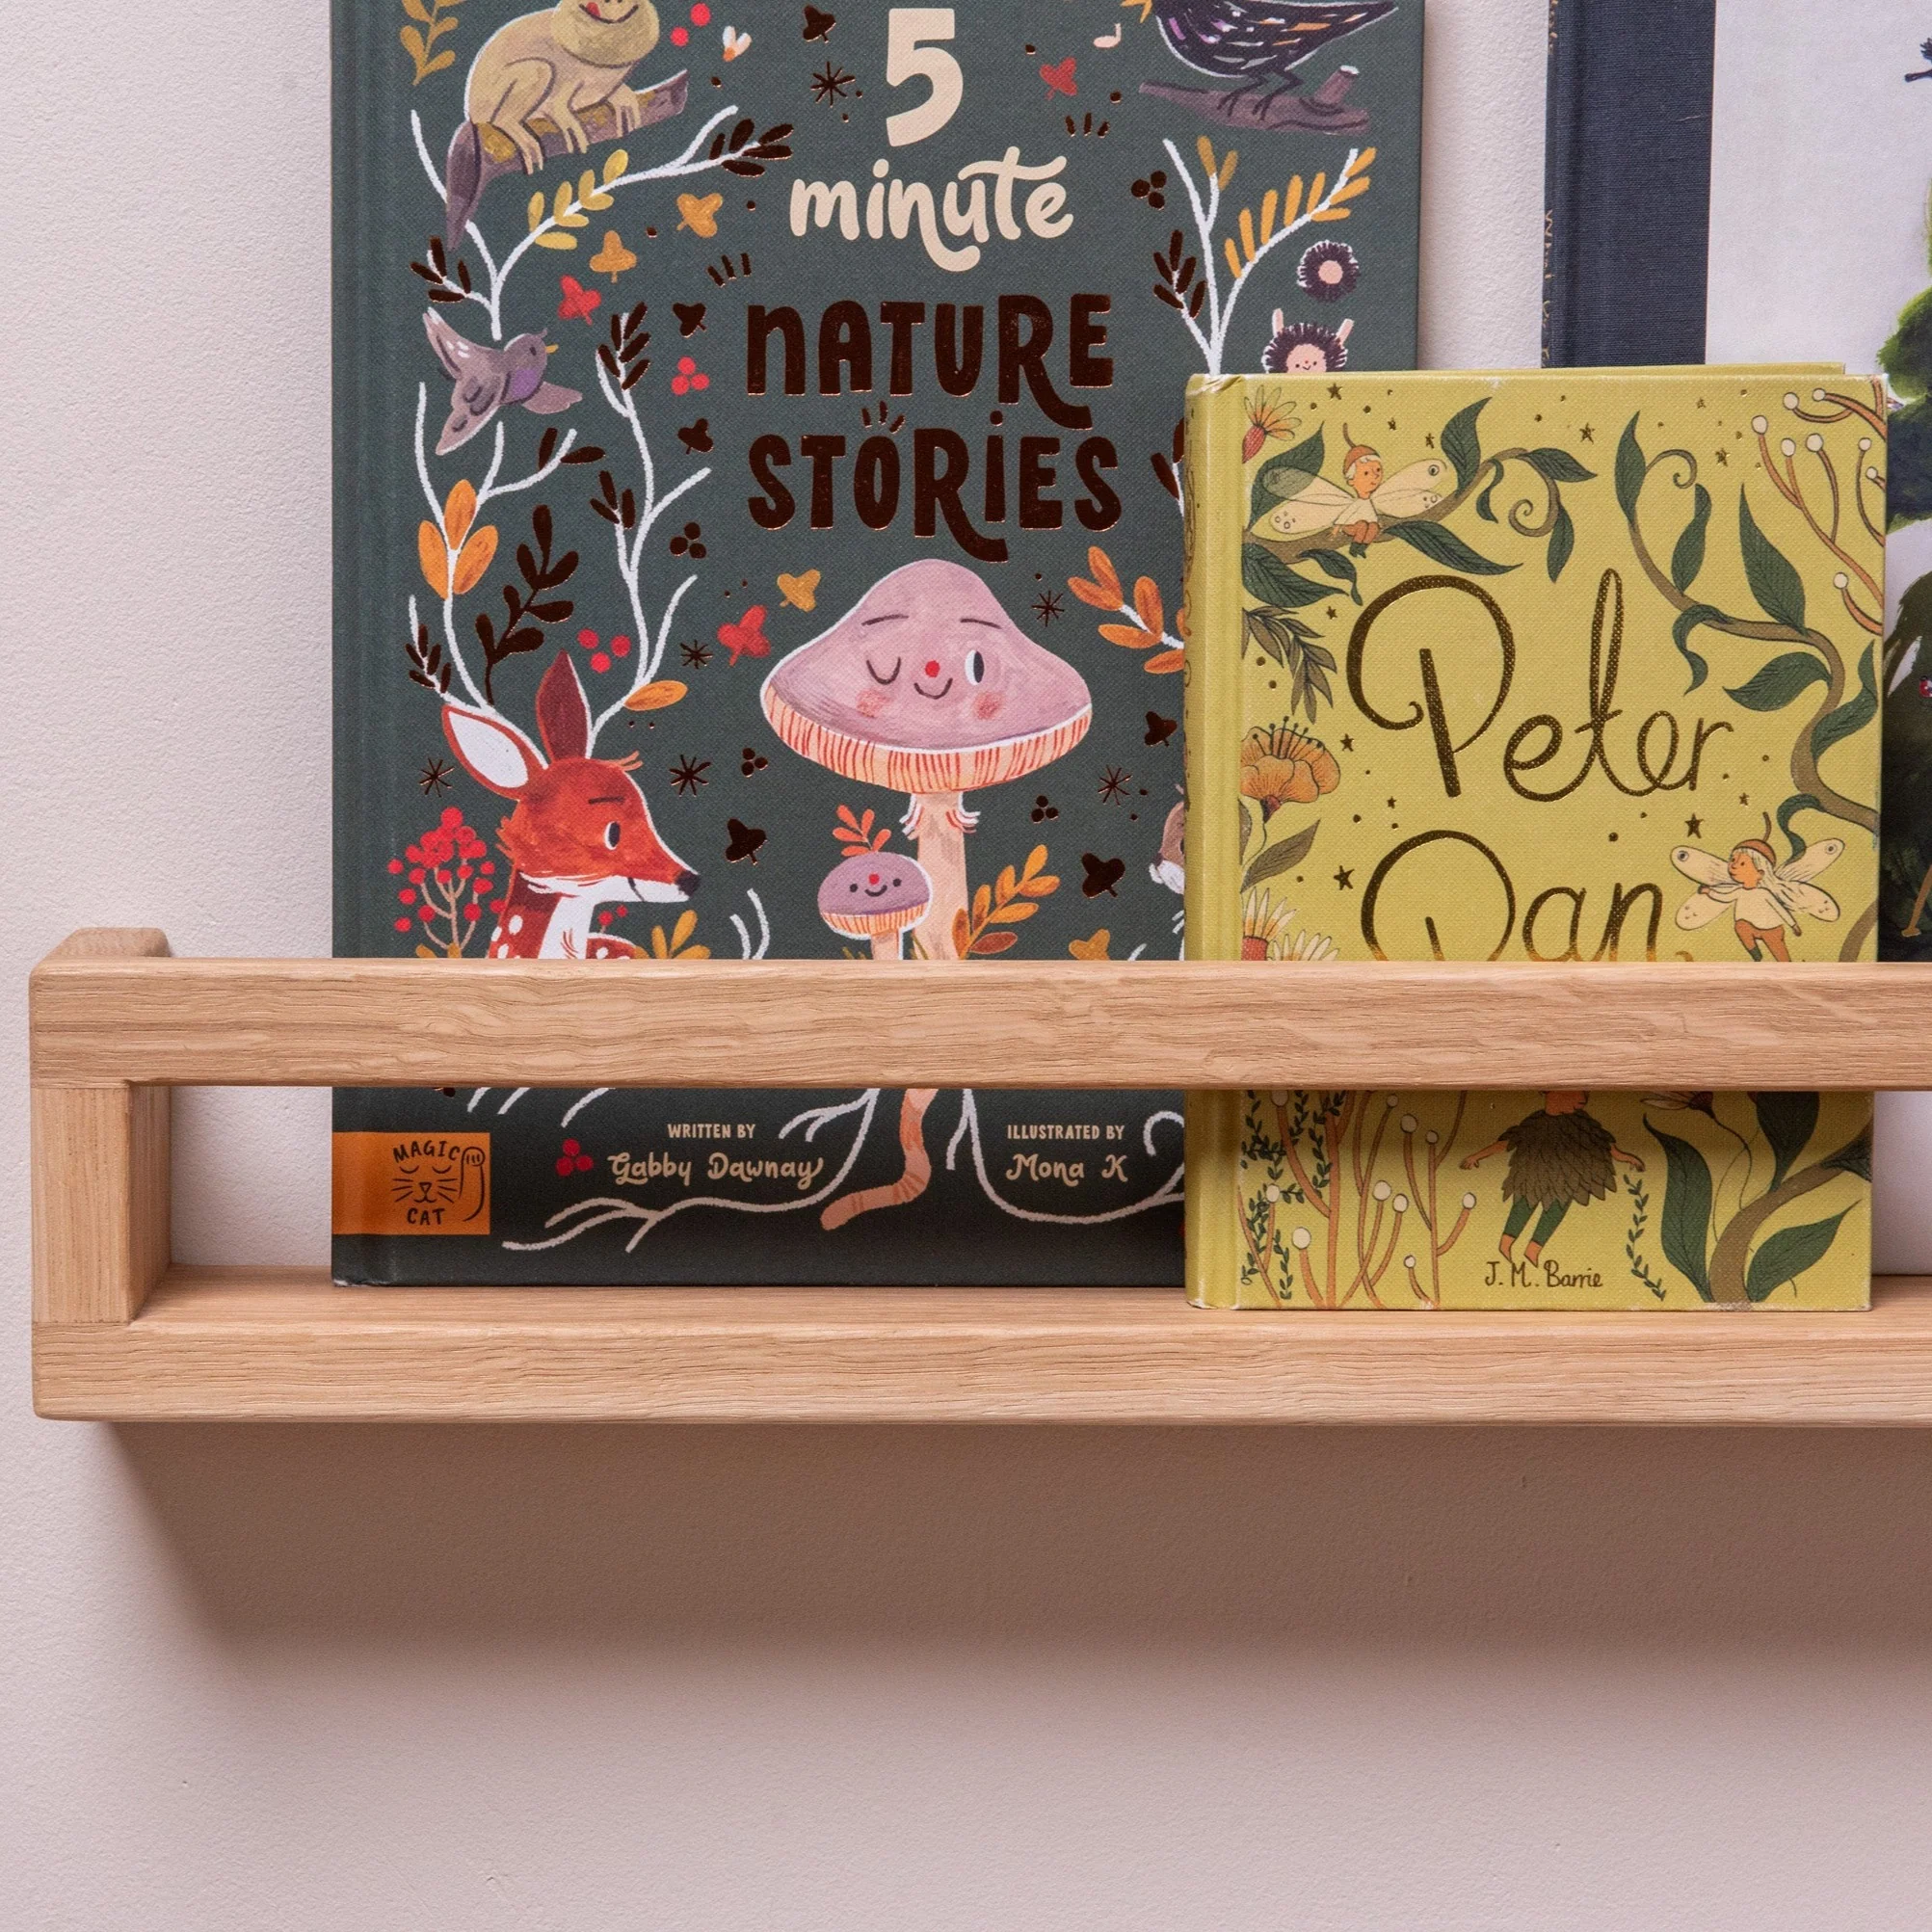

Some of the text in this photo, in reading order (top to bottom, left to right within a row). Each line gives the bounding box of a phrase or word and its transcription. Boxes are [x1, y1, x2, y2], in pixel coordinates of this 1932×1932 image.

[886, 8, 964, 146] 5
[789, 146, 1074, 272] minute
[1346, 569, 1734, 803] Peter
[1361, 830, 1663, 962] Pan
[668, 1124, 755, 1139] WRITTEN BY
[1007, 1125, 1125, 1140] ILLUSTRATED BY
[393, 1140, 461, 1163] MAGIC
[607, 1152, 824, 1190] Gabby Dawnay
[1005, 1153, 1128, 1187] Mona K
[407, 1207, 445, 1226] CAT
[1544, 1259, 1603, 1288] Barrie
